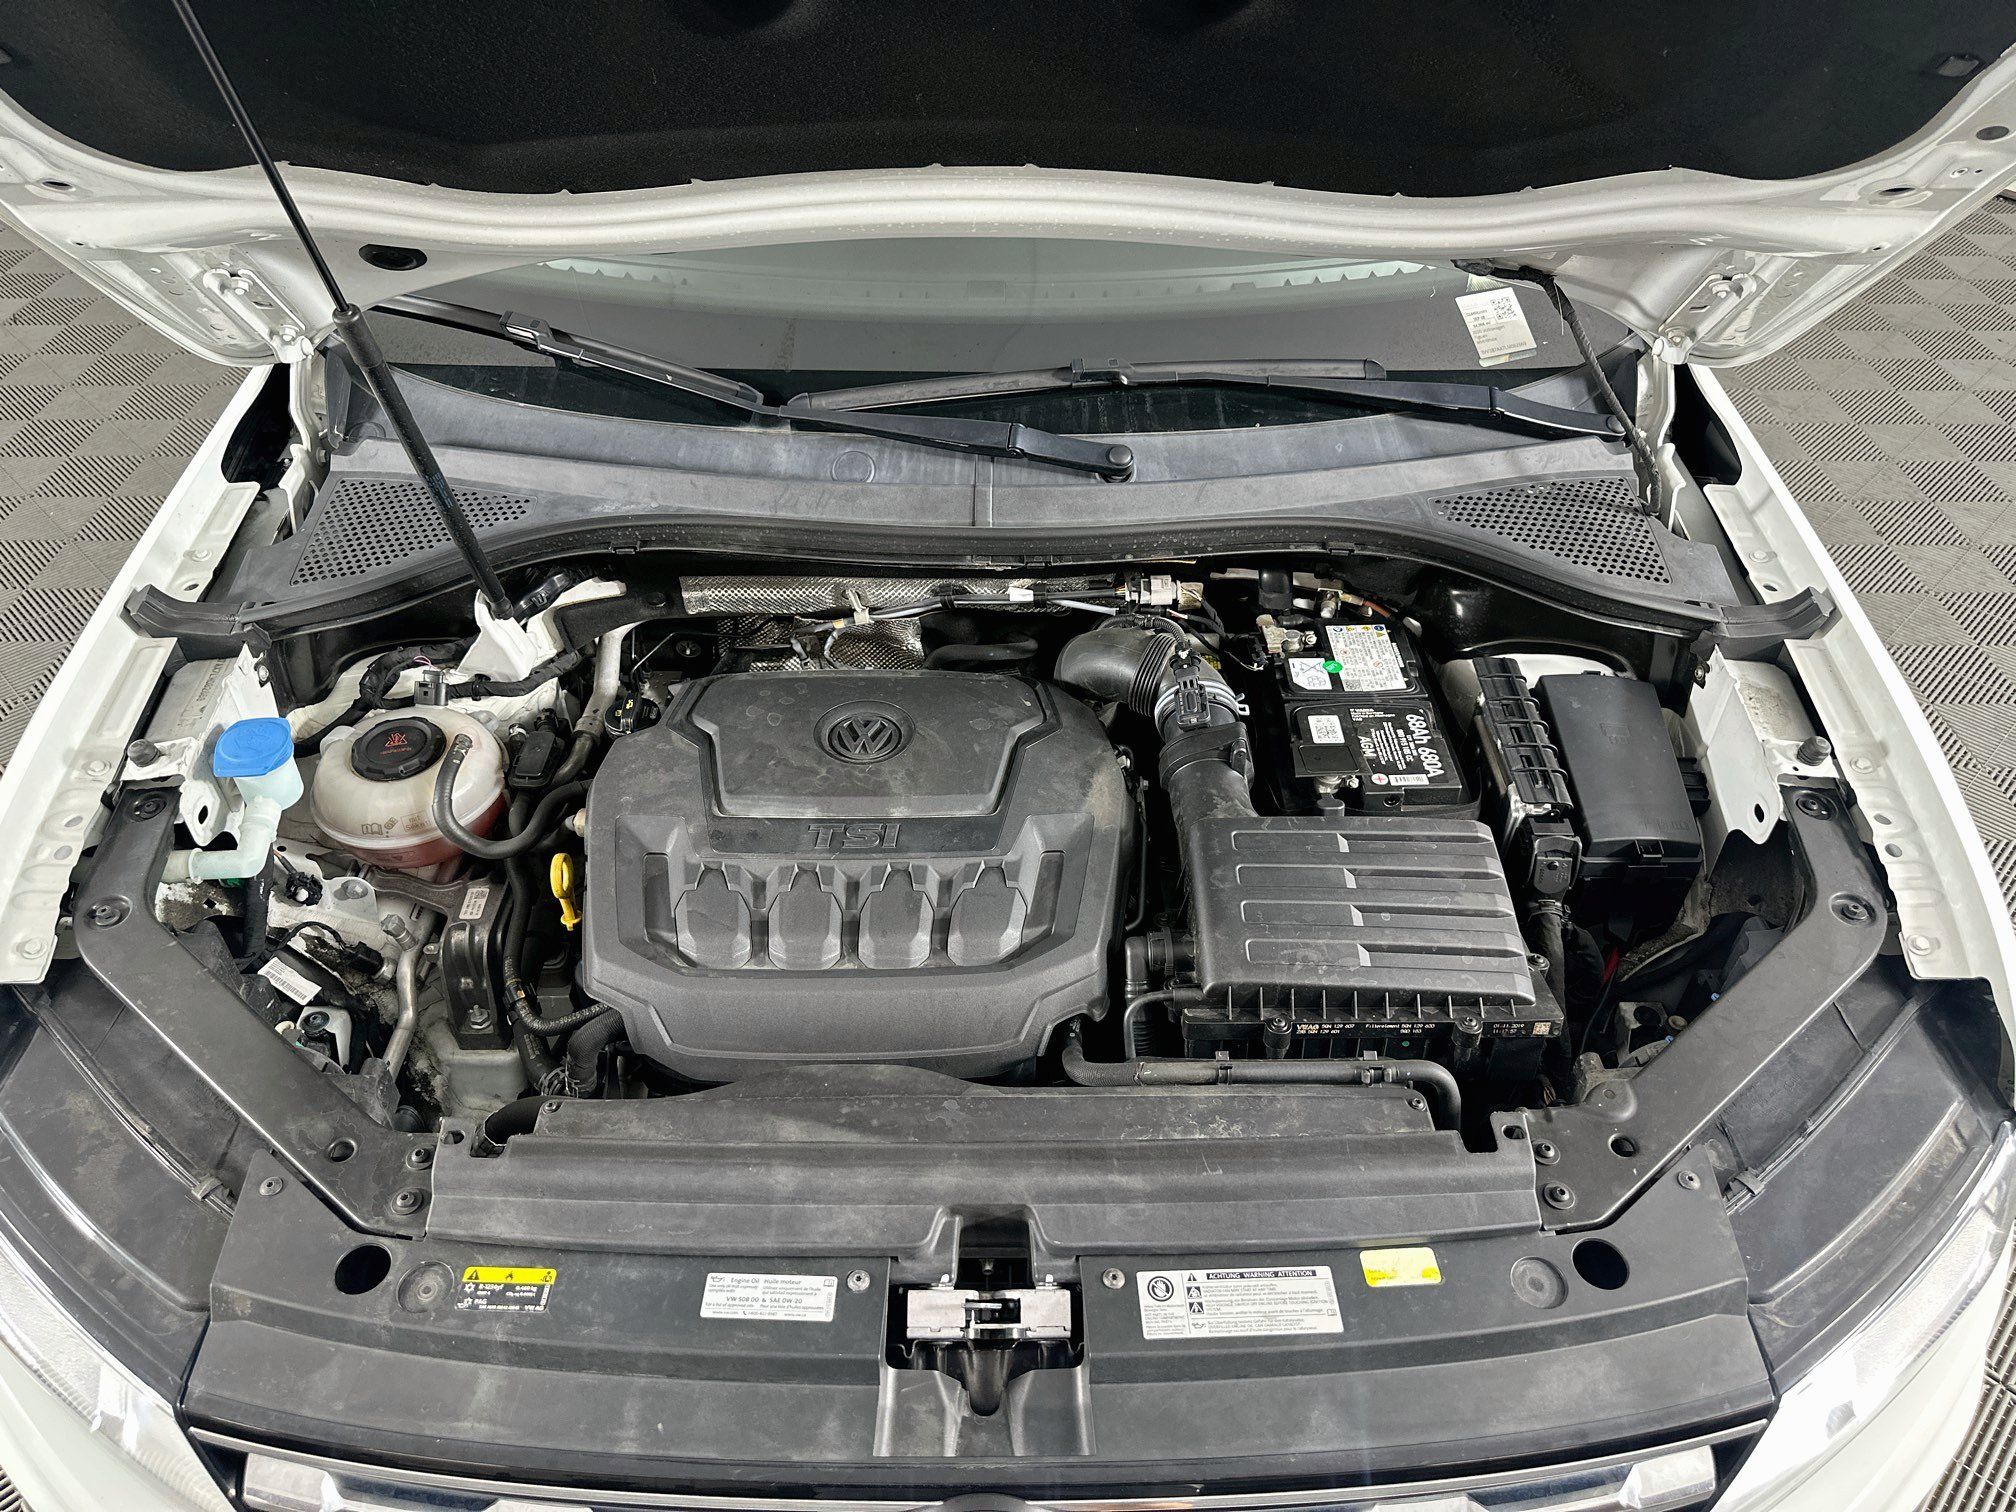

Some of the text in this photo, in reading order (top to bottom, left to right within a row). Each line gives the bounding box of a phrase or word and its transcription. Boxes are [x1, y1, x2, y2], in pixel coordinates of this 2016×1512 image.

[1358, 735, 1377, 757] AGM
[1405, 714, 1444, 777] 68Ah 680A
[808, 822, 901, 849] TSI
[1242, 1271, 1275, 1279] WARNING
